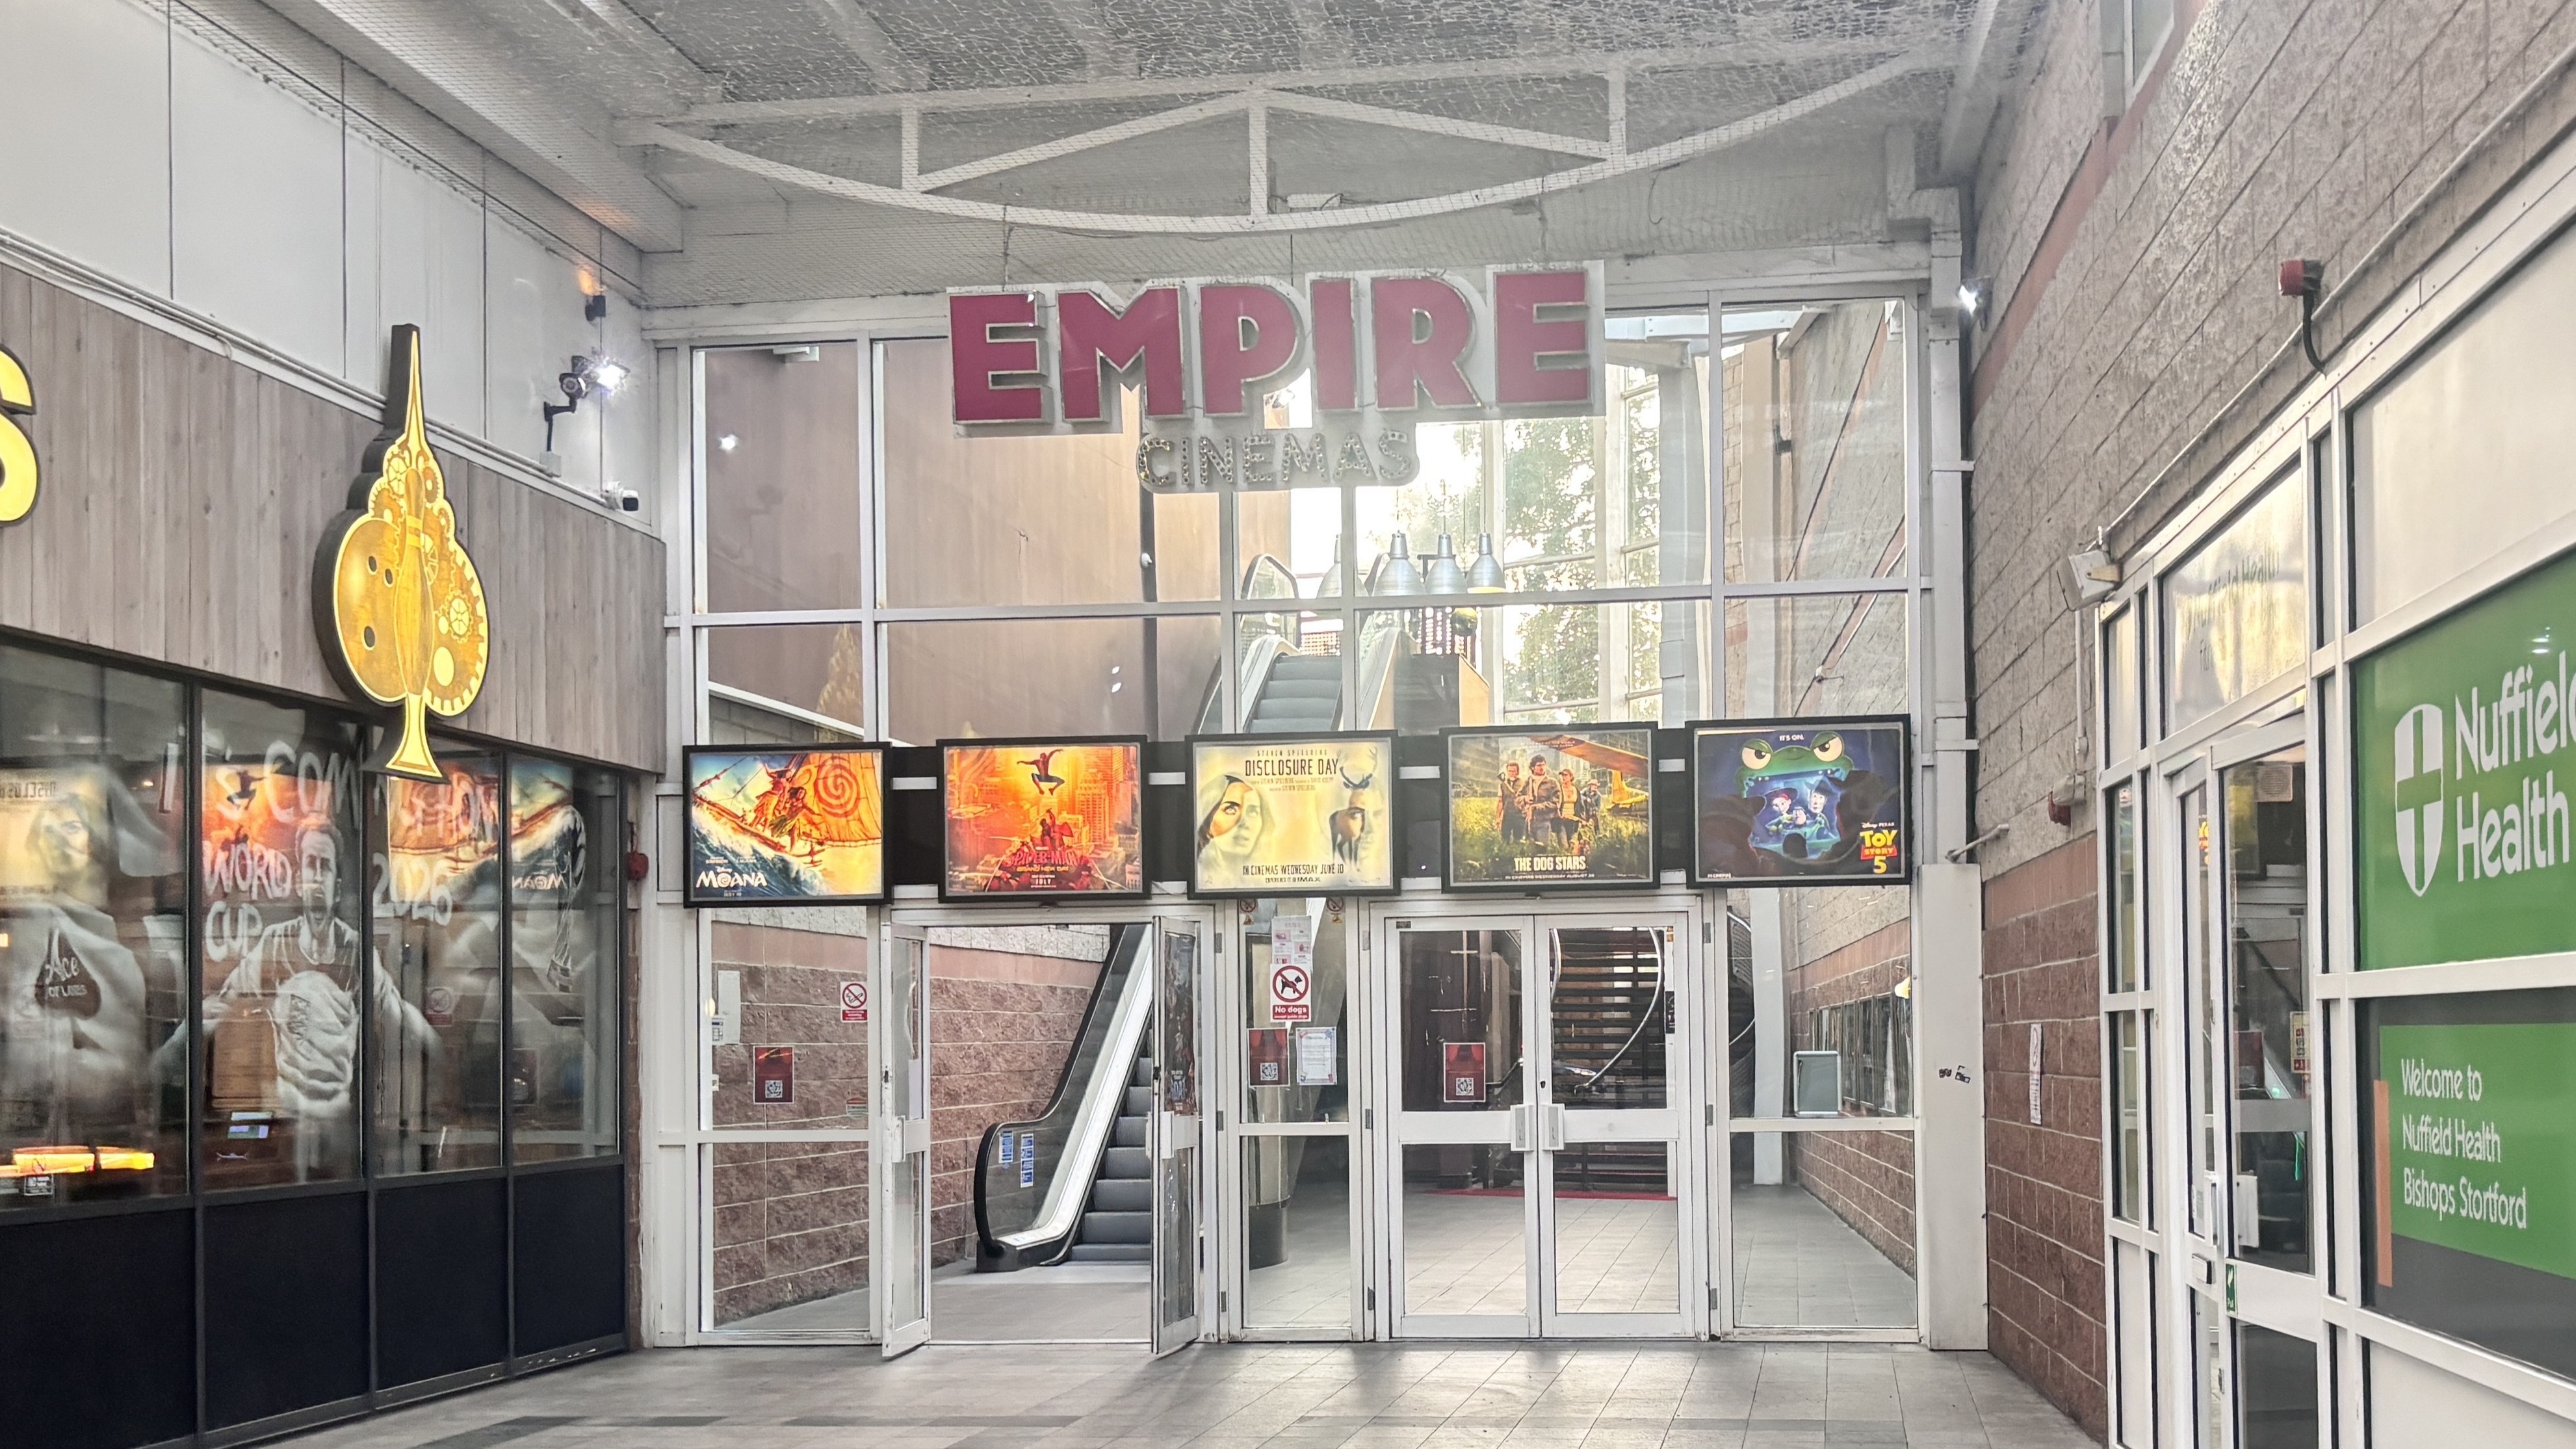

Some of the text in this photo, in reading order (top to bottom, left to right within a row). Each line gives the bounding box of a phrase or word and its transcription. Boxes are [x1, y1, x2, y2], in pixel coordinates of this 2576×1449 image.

[950, 270, 1591, 423] EMPIRE
[1138, 432, 1412, 485] CINEMAS
[2455, 650, 2576, 779] Nuffiel
[1245, 758, 1338, 776] DISCLOSURE DAY
[1860, 829, 1898, 847] TOY
[2456, 770, 2569, 881] Health
[696, 870, 768, 889] MOANA
[1251, 865, 1278, 875] CINEMAS
[1281, 865, 1318, 875] WEDNESDAY
[1320, 864, 1335, 874] JUNE
[1337, 864, 1344, 874] 10
[1514, 856, 1586, 871] THE DOG STARS
[1873, 855, 1887, 874] 5
[372, 852, 453, 926] 2026
[205, 900, 263, 962] CUP
[1288, 1006, 1307, 1015] dogs
[2401, 1058, 2482, 1101] Welcome to
[2402, 1113, 2501, 1163] Nuffield Health
[2404, 1168, 2527, 1229] Bishops Stortford
